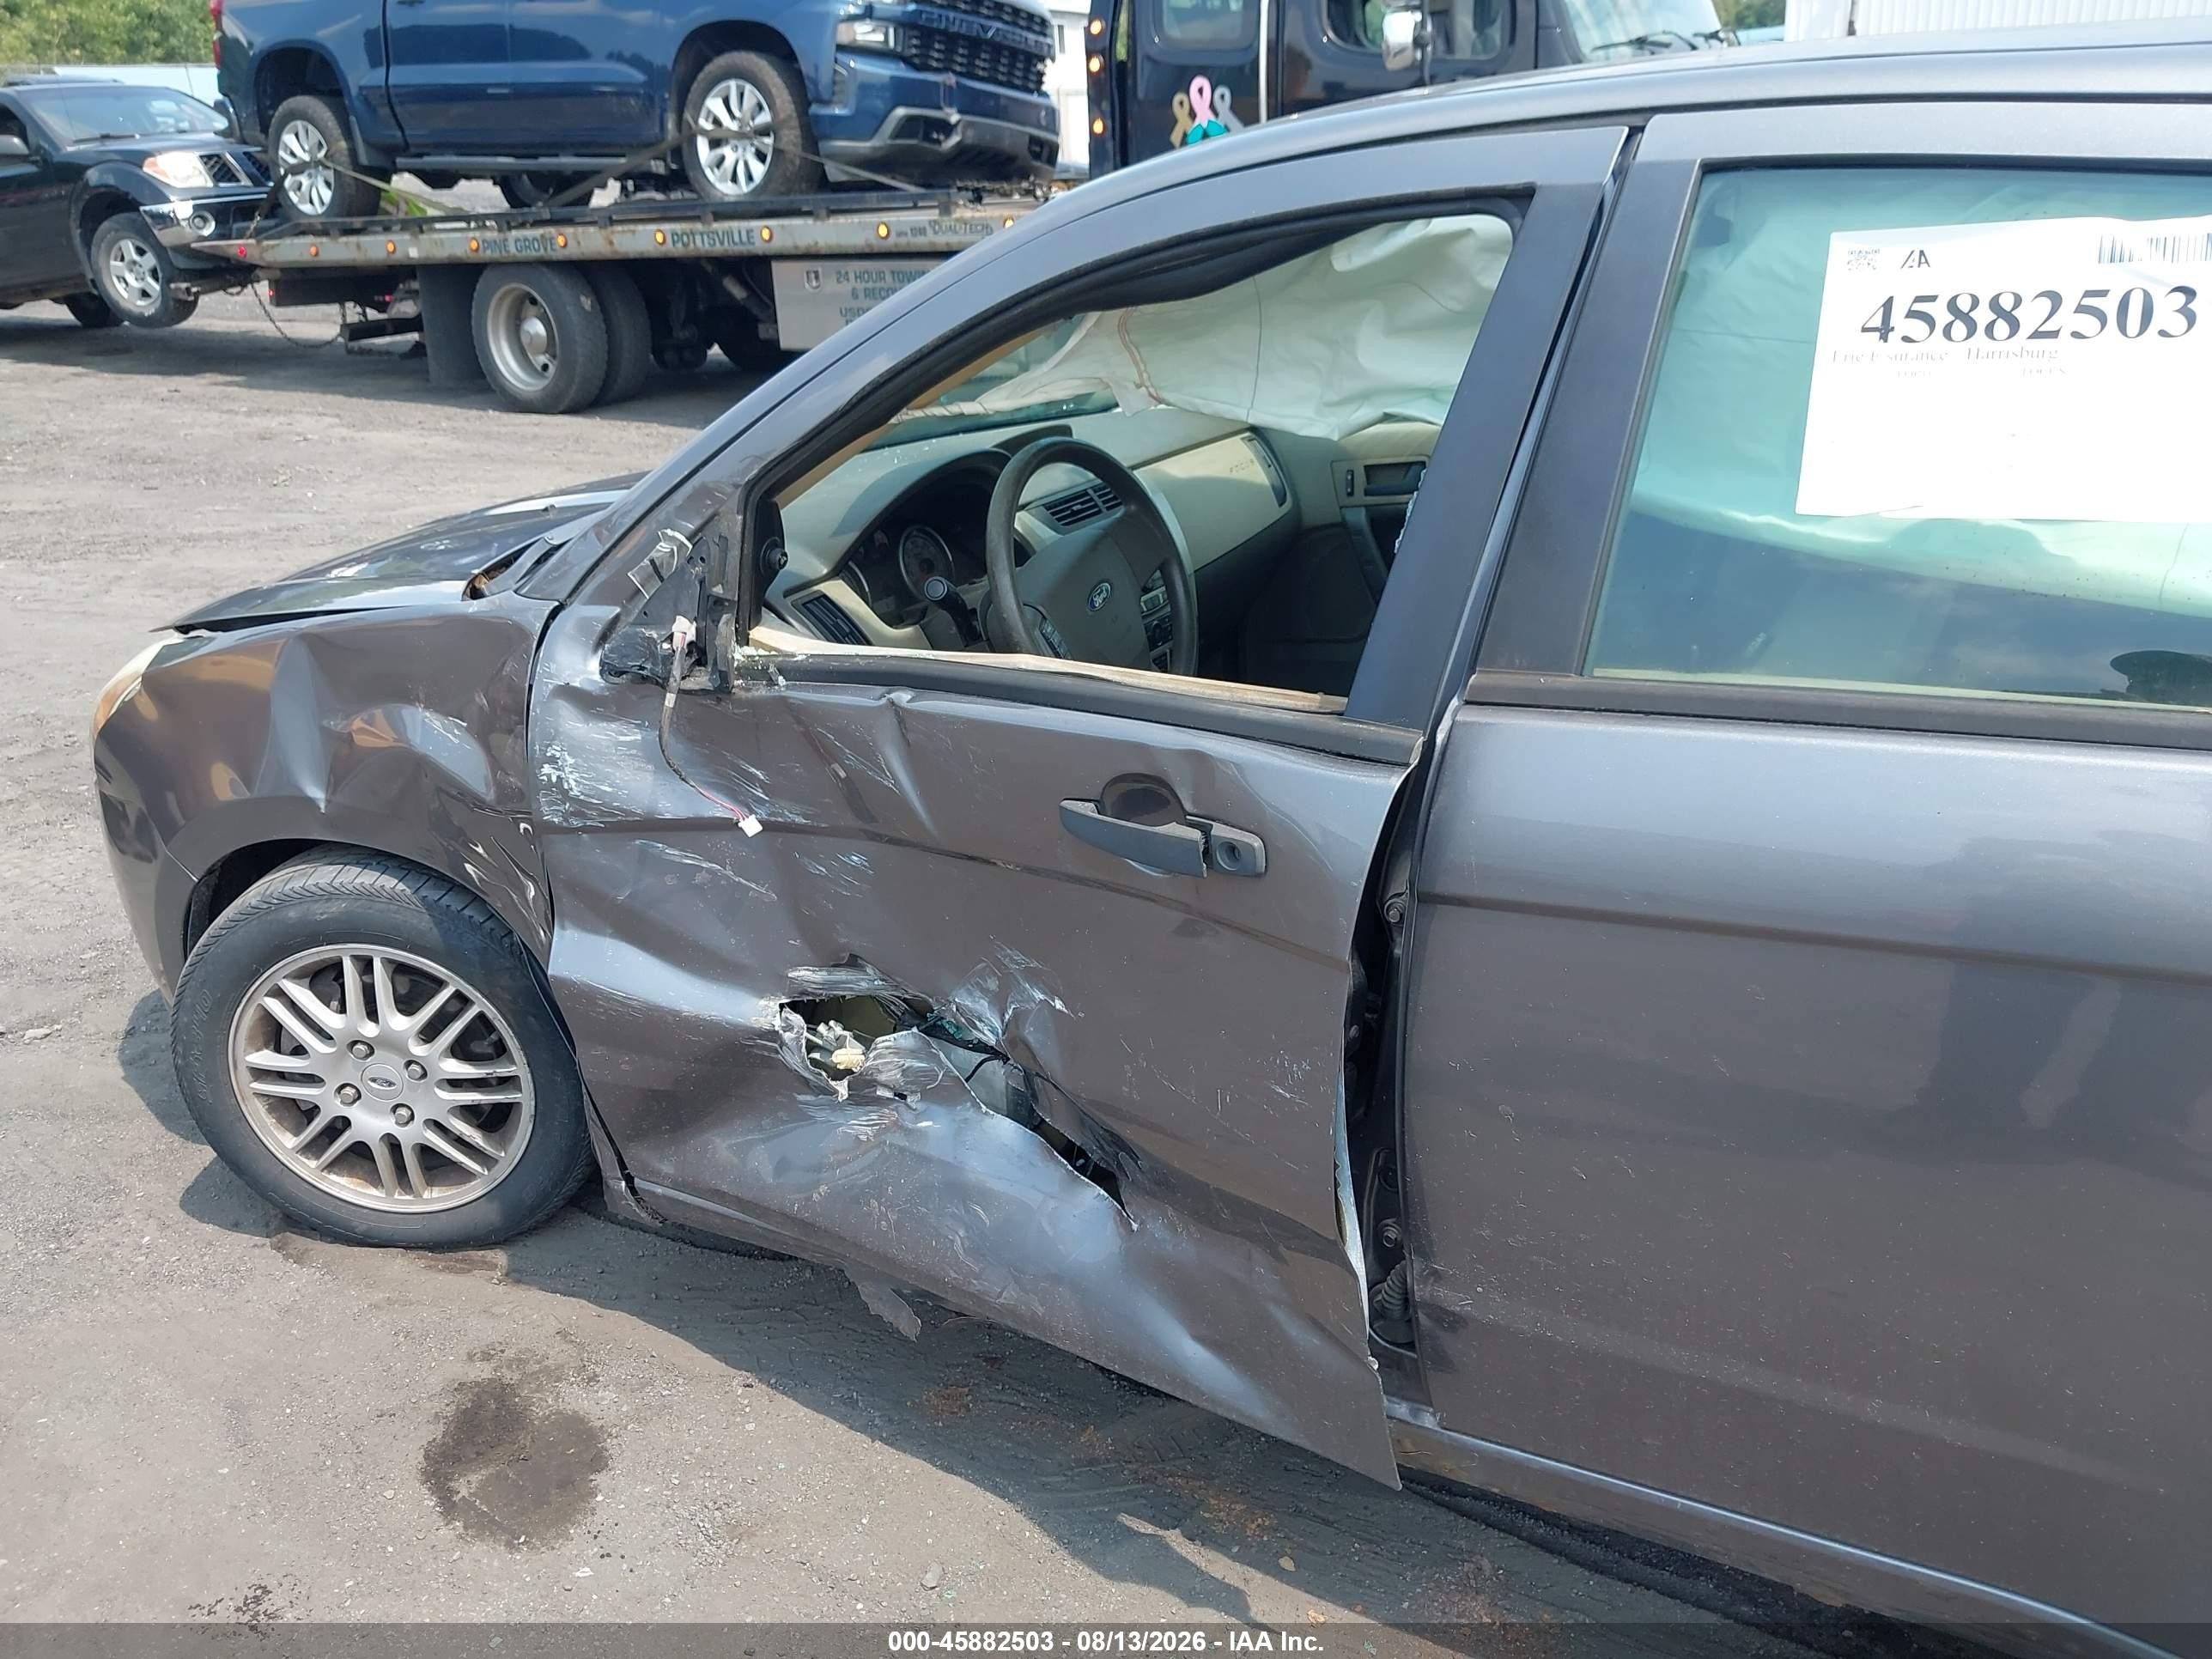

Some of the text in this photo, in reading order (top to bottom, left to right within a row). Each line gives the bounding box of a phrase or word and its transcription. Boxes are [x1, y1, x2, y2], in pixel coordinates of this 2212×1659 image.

[482, 234, 557, 255] PINE GROVE
[671, 227, 756, 247] POTTSVILLE
[836, 270, 850, 283] 24
[854, 269, 887, 284] HOUR
[1860, 285, 2198, 343] 45882503
